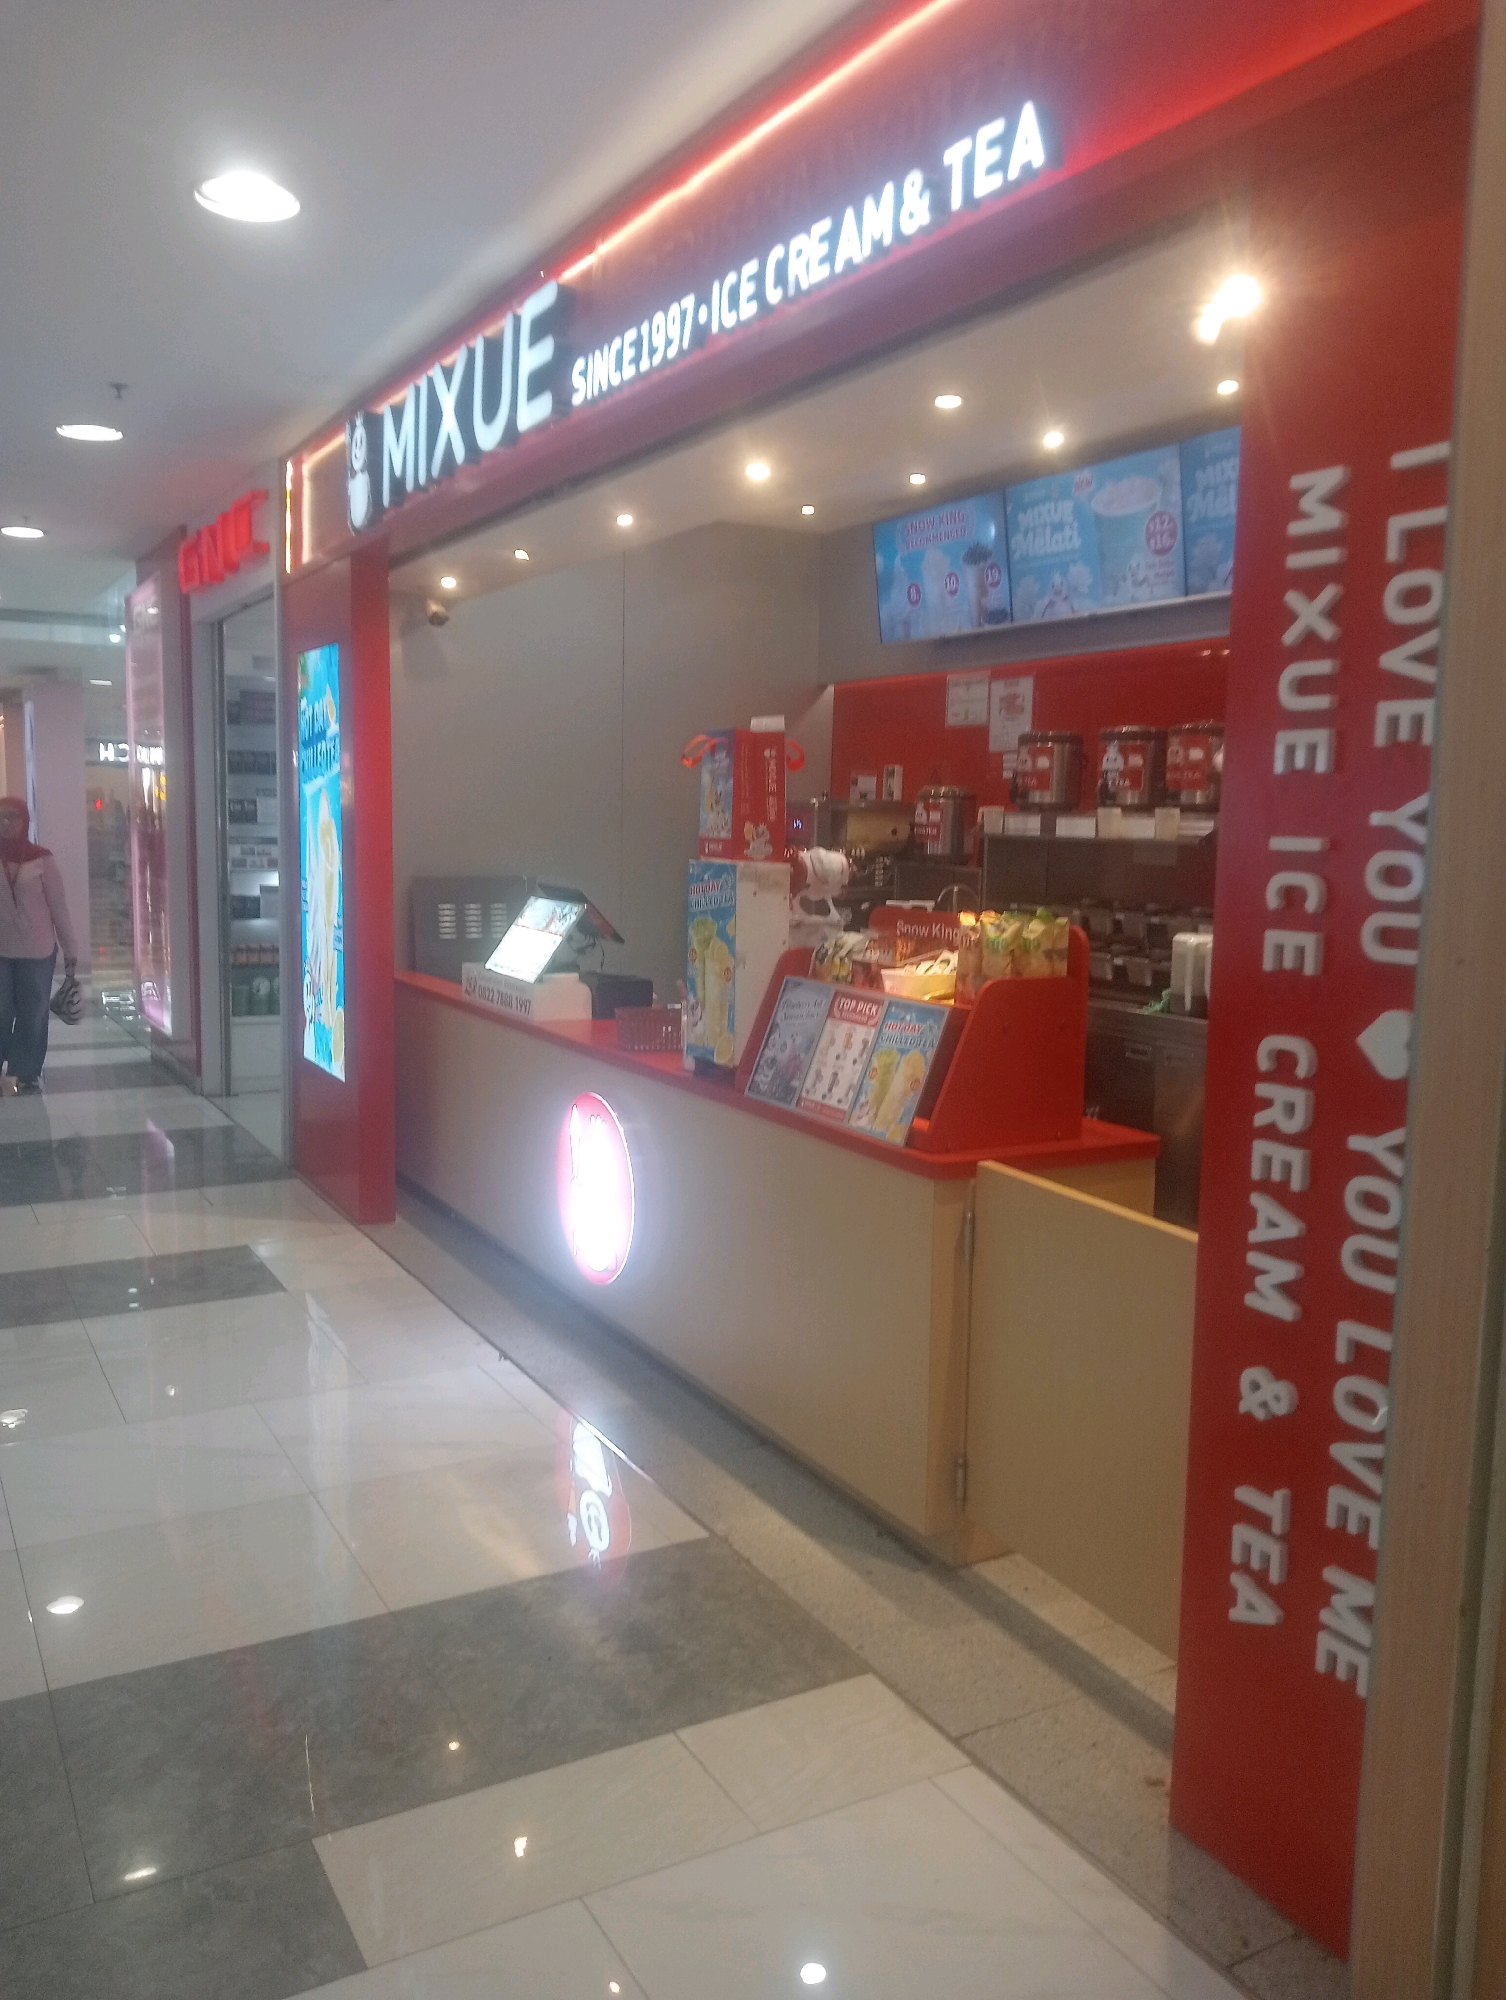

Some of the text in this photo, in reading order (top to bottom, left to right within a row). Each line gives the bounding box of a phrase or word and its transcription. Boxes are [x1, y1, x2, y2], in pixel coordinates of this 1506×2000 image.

[571, 99, 1045, 407] SINCE 1997 ICE CREAM & TEA
[382, 279, 558, 509] MIXUE
[905, 508, 965, 535] SNOW KING
[838, 998, 856, 1013] TOP
[857, 1002, 879, 1016] PICK
[896, 919, 929, 937] Snow
[931, 922, 960, 945] King
[1228, 465, 1347, 1627] MIXUE ICE CREAM & TEA
[1314, 441, 1450, 1698] I LOVE YOU YOU LOVE ME
